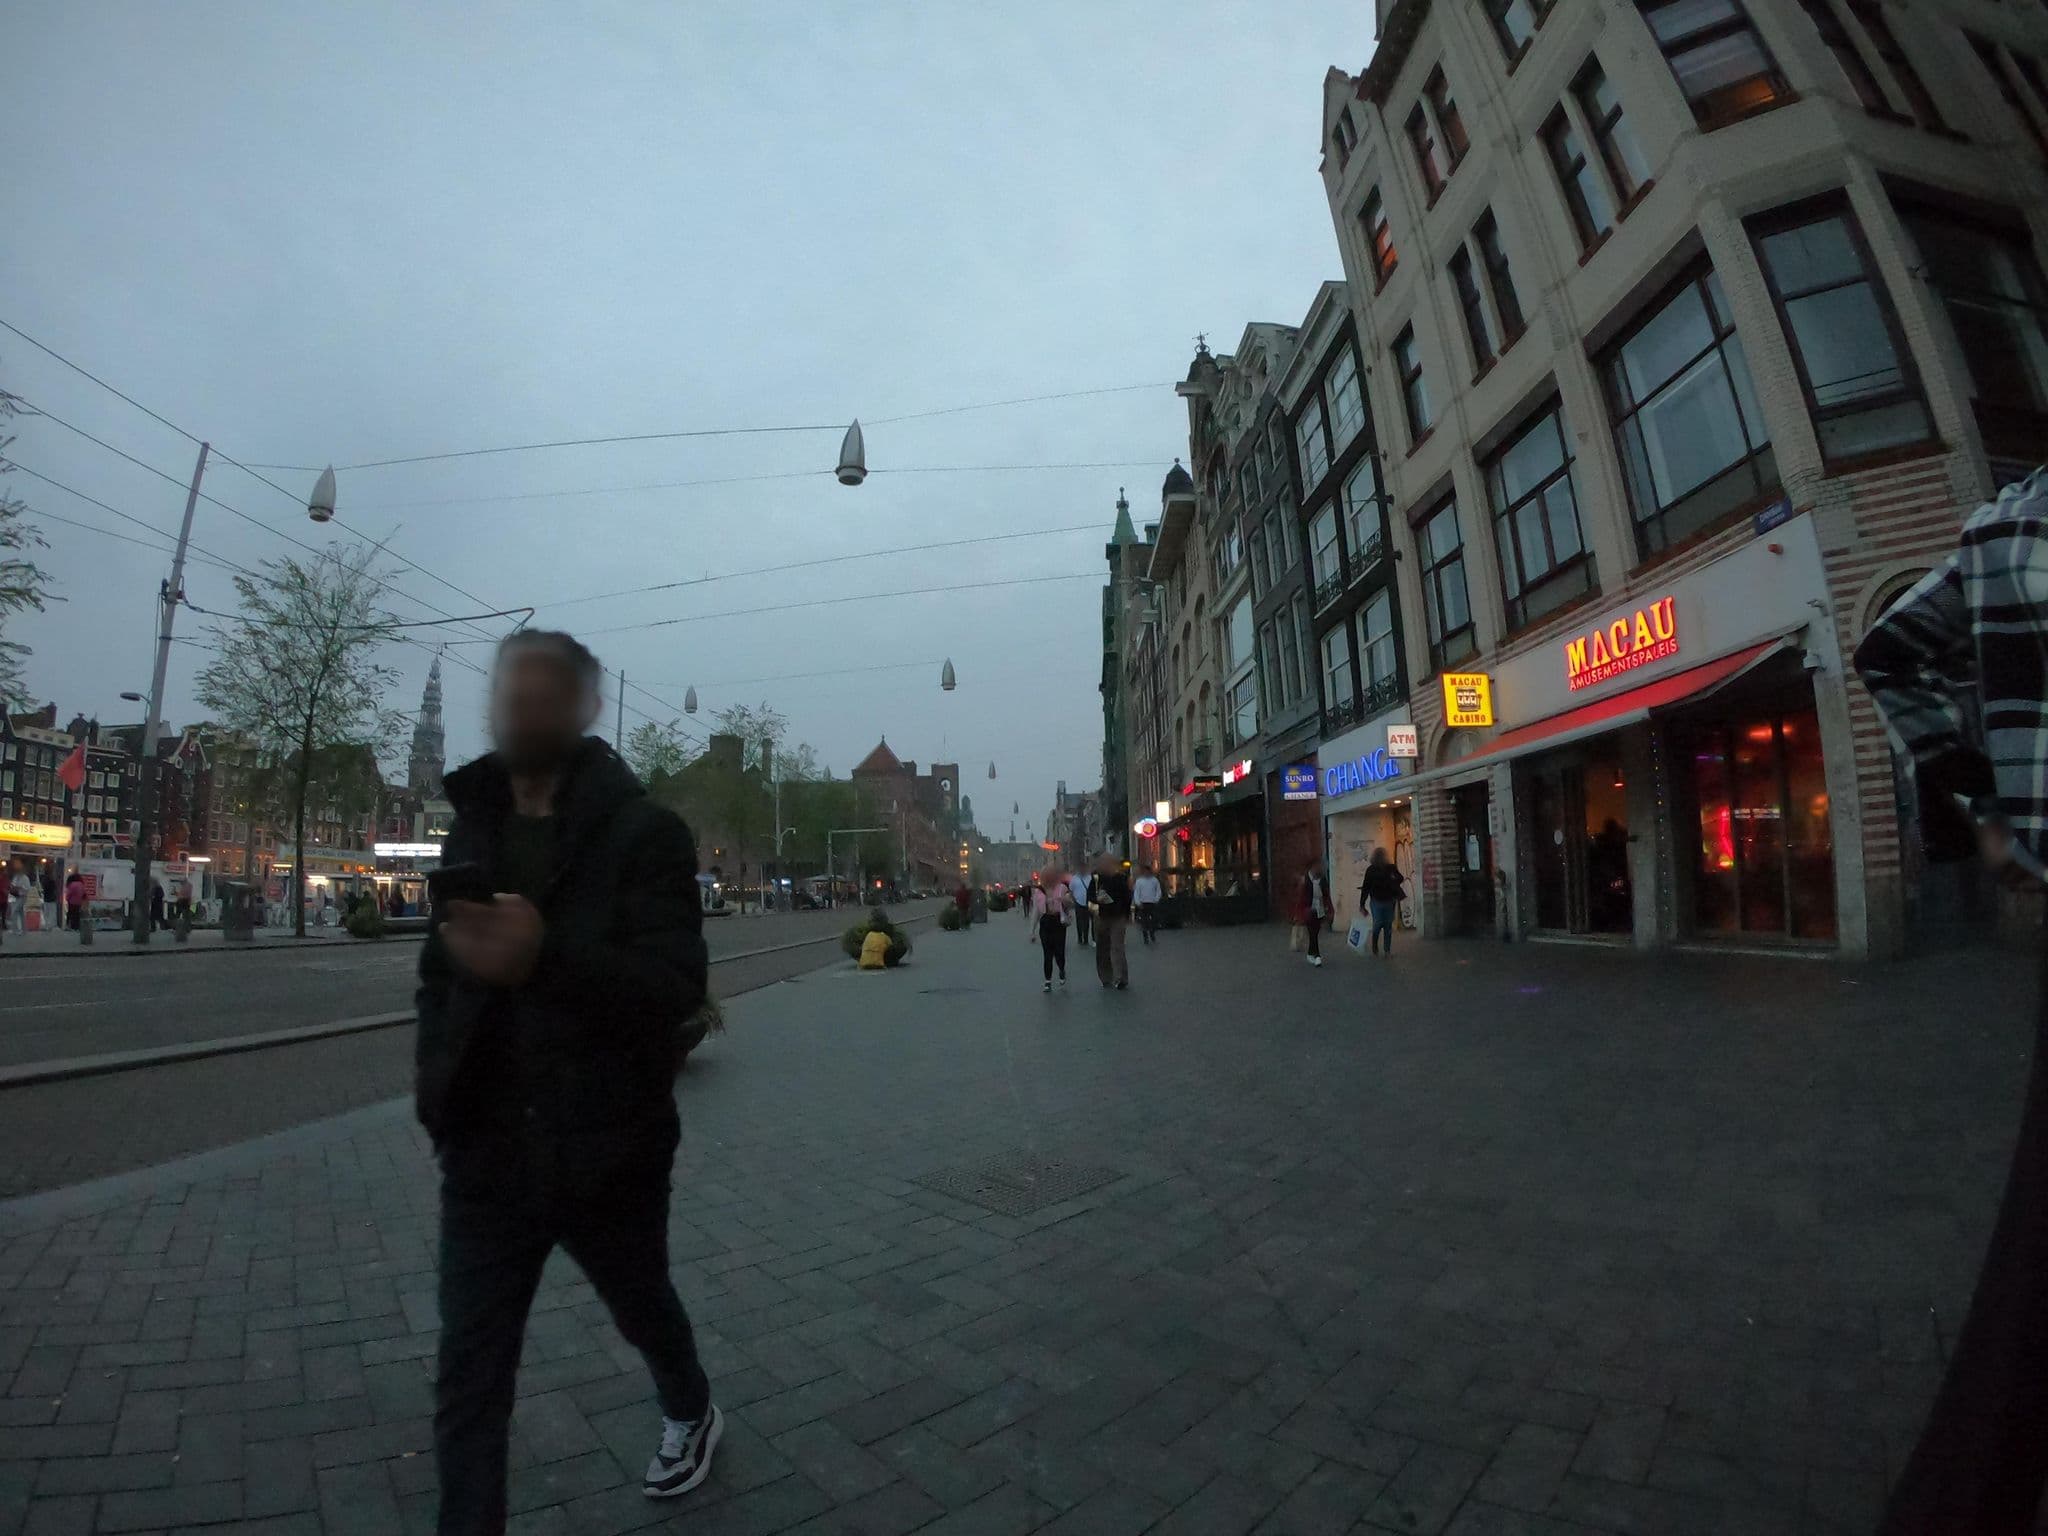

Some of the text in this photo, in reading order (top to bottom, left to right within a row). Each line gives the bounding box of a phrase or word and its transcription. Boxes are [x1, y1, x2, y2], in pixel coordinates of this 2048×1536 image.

[1565, 597, 1676, 678] MACAU
[1569, 638, 1678, 691] AMUSEMENTSPALEIS
[1450, 677, 1482, 686] MACAU
[1453, 714, 1486, 723] CASINO
[1390, 734, 1415, 744] ATM
[2, 822, 35, 834] CRUISE
